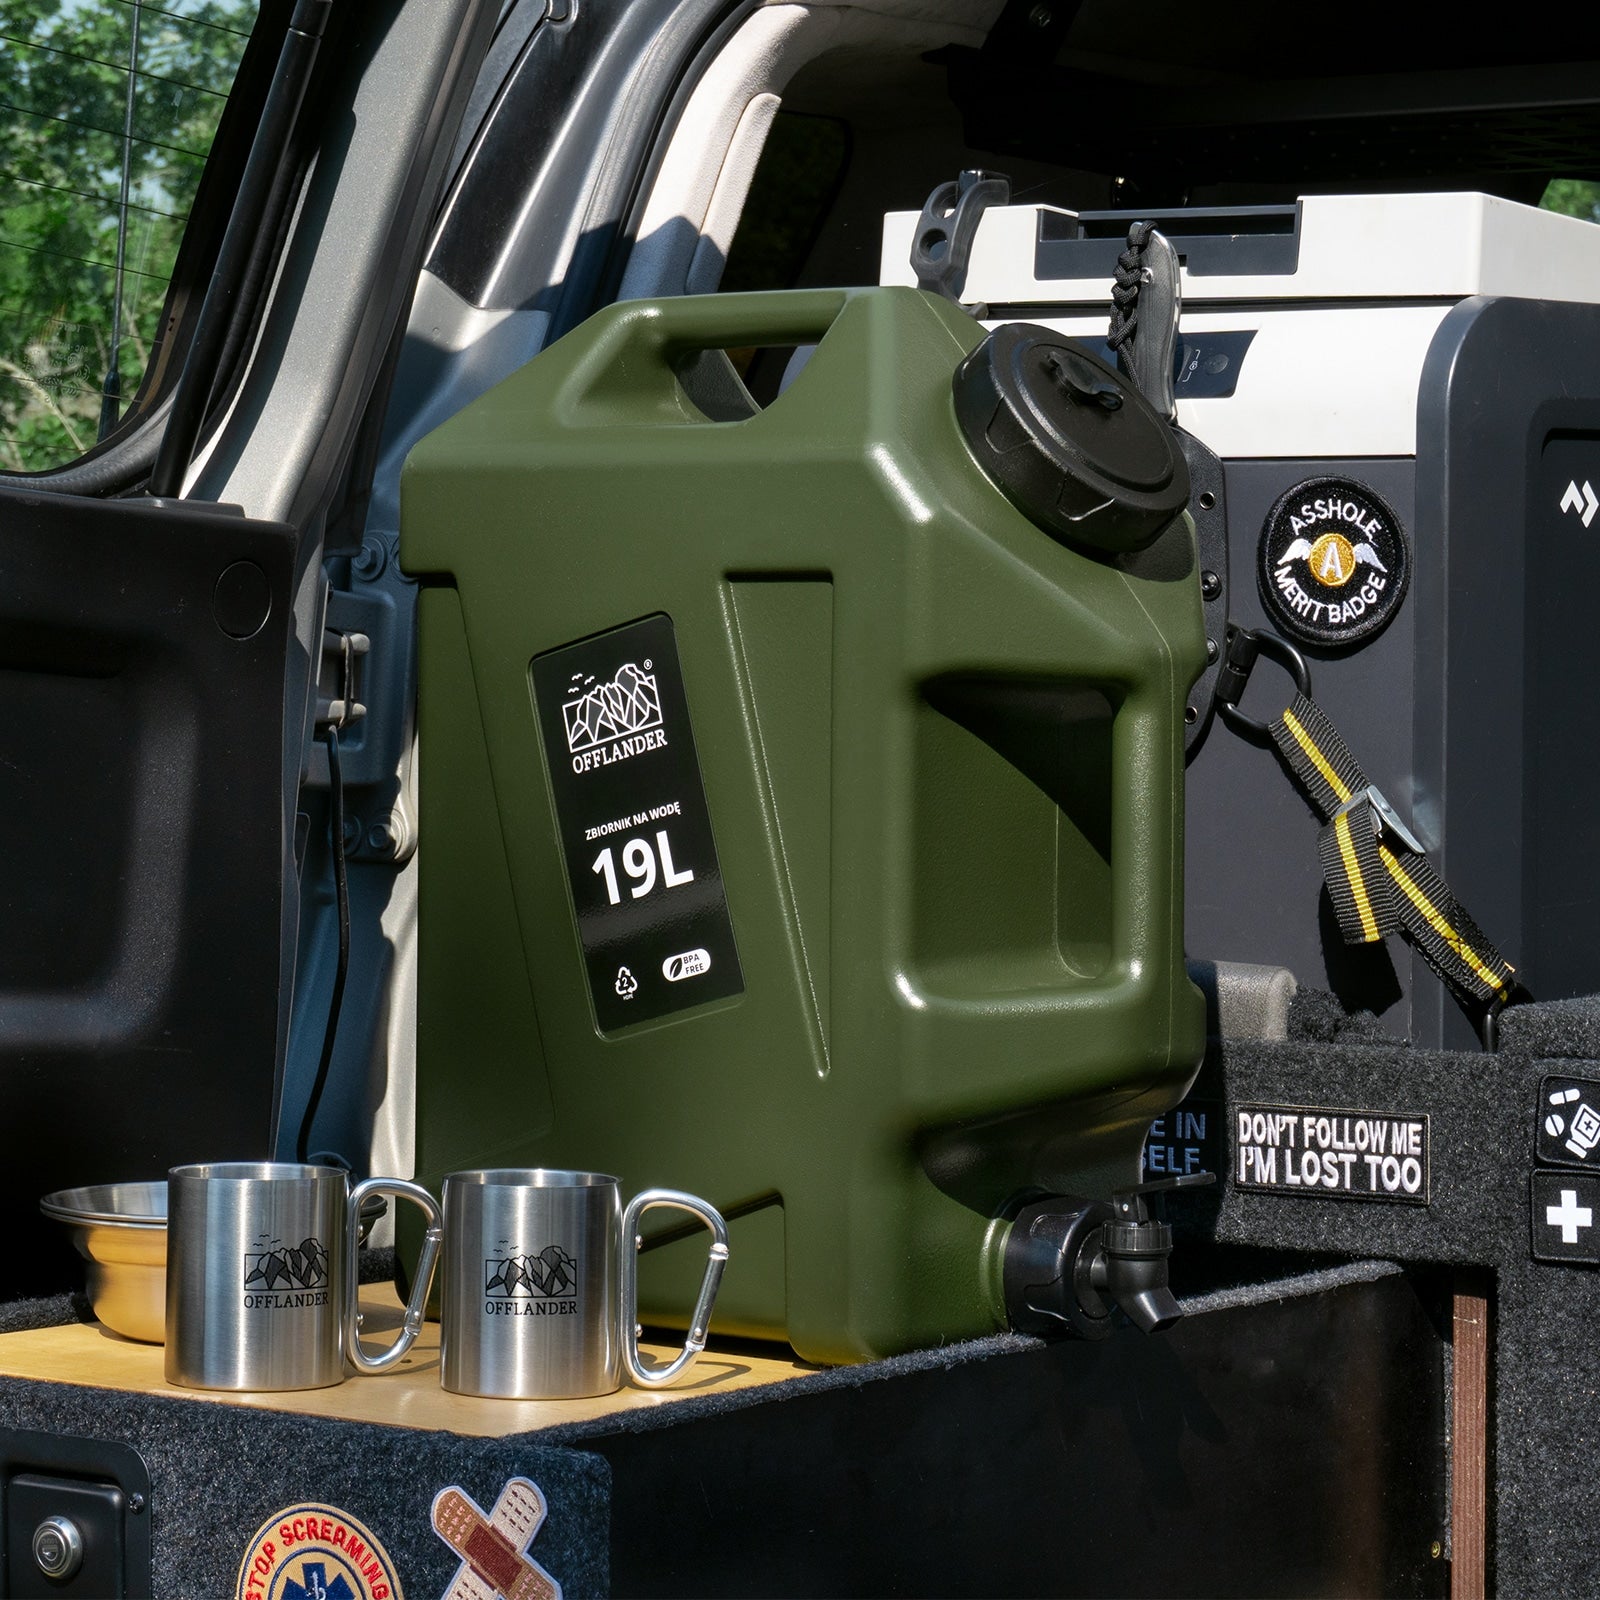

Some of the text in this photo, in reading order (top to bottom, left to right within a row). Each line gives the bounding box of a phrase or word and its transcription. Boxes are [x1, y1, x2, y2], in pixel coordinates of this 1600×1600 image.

[1290, 499, 1382, 543] ASSHOLE
[1320, 542, 1343, 579] A
[1274, 566, 1386, 623] MERIT BADGE
[572, 728, 668, 774] OFFLANDER
[585, 801, 681, 840] ZBIORNIK NA WODĘ
[592, 830, 694, 905] 19L
[683, 954, 700, 964] BPA
[685, 963, 704, 975] FREE
[1176, 1111, 1206, 1140] IN
[1238, 1112, 1423, 1156] DON'T FOLLOW ME
[1143, 1144, 1207, 1175] ELF.
[1239, 1146, 1421, 1193] I'M LOST TOO
[244, 1292, 329, 1309] OFFLANDER
[485, 1301, 578, 1316] OFFLANDER
[279, 1517, 389, 1600] SCREAMING
